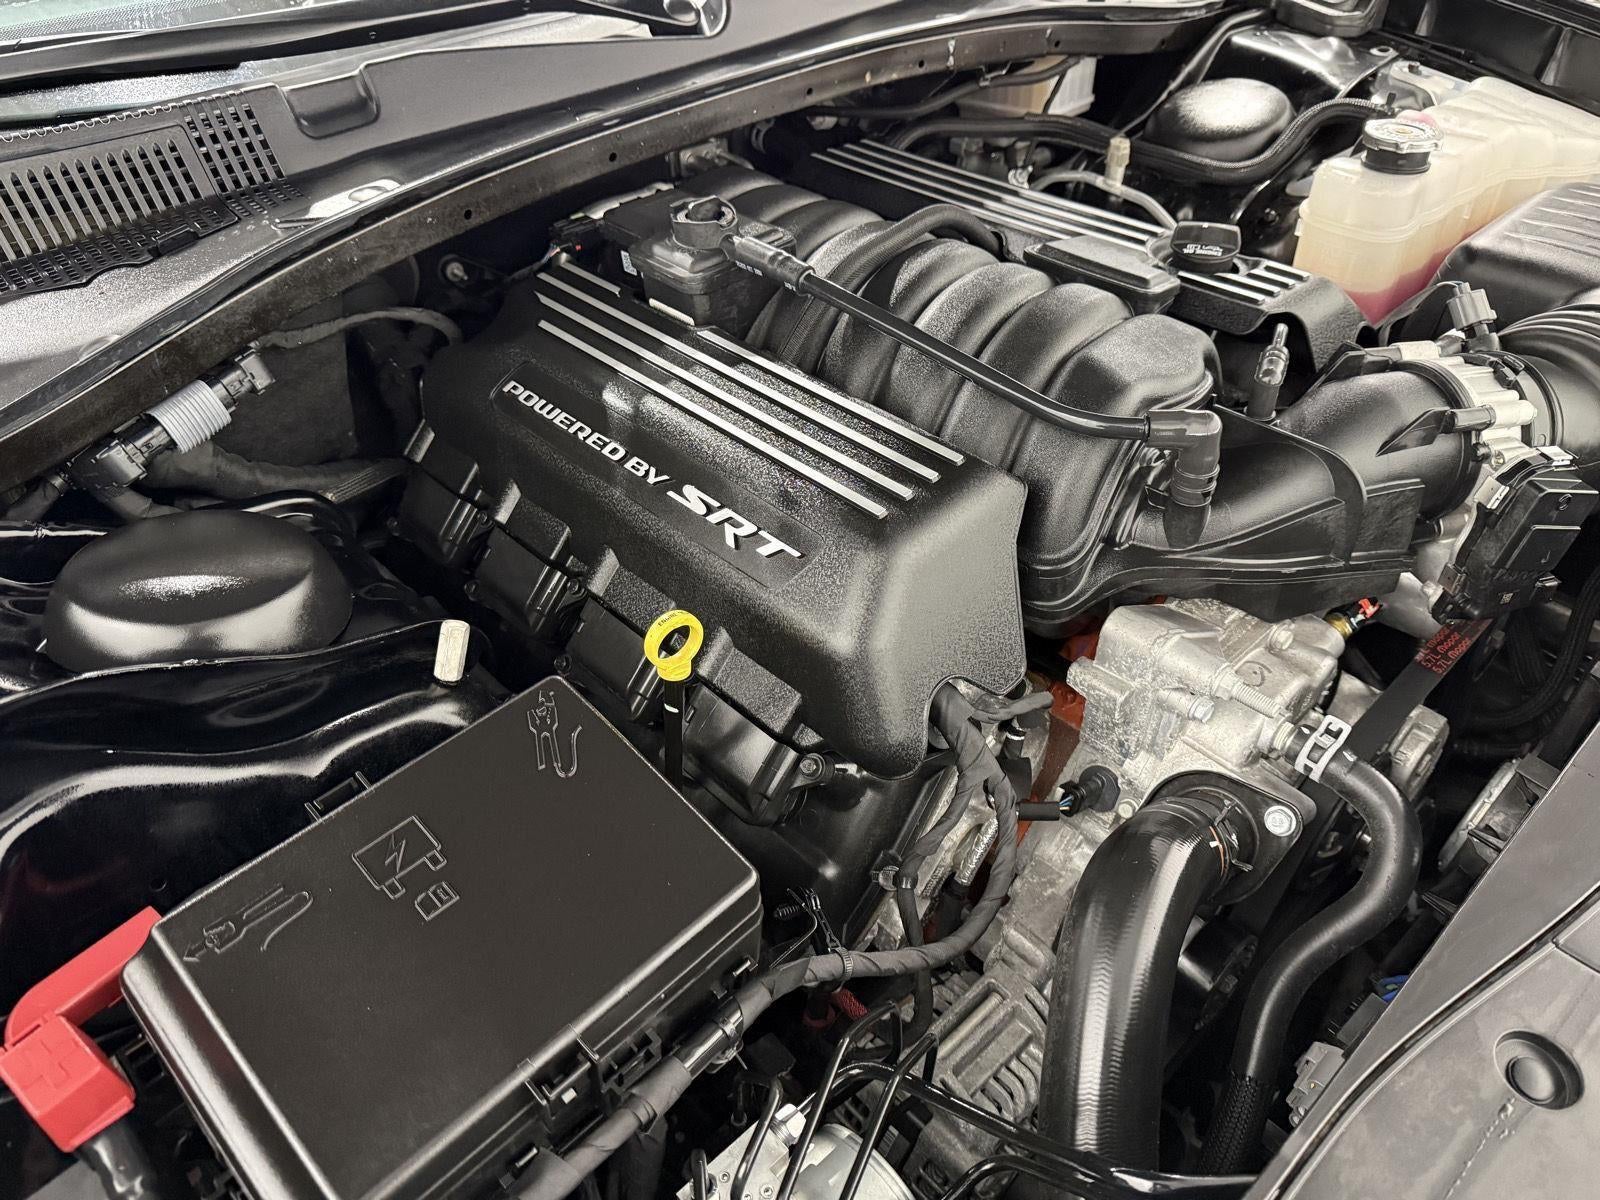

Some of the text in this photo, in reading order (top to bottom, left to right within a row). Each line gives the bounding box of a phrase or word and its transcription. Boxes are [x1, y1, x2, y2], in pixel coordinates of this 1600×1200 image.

[502, 380, 802, 558] POWERED BY SRT
